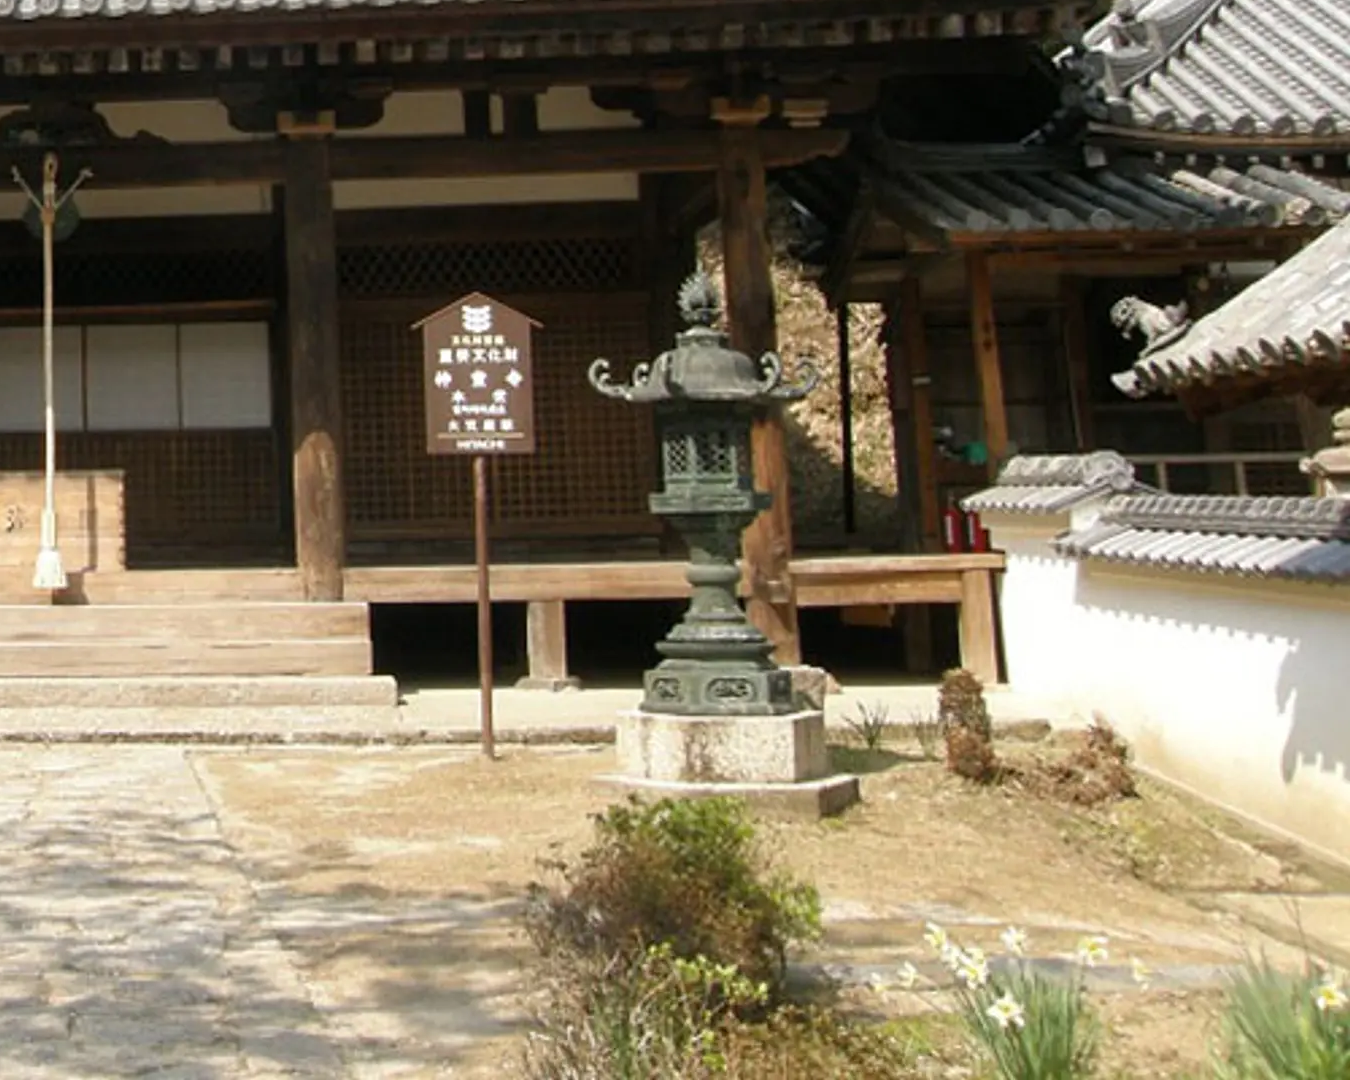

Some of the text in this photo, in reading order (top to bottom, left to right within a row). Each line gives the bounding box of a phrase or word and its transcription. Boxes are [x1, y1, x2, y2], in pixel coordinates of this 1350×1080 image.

[439, 347, 518, 363] 重要文化財
